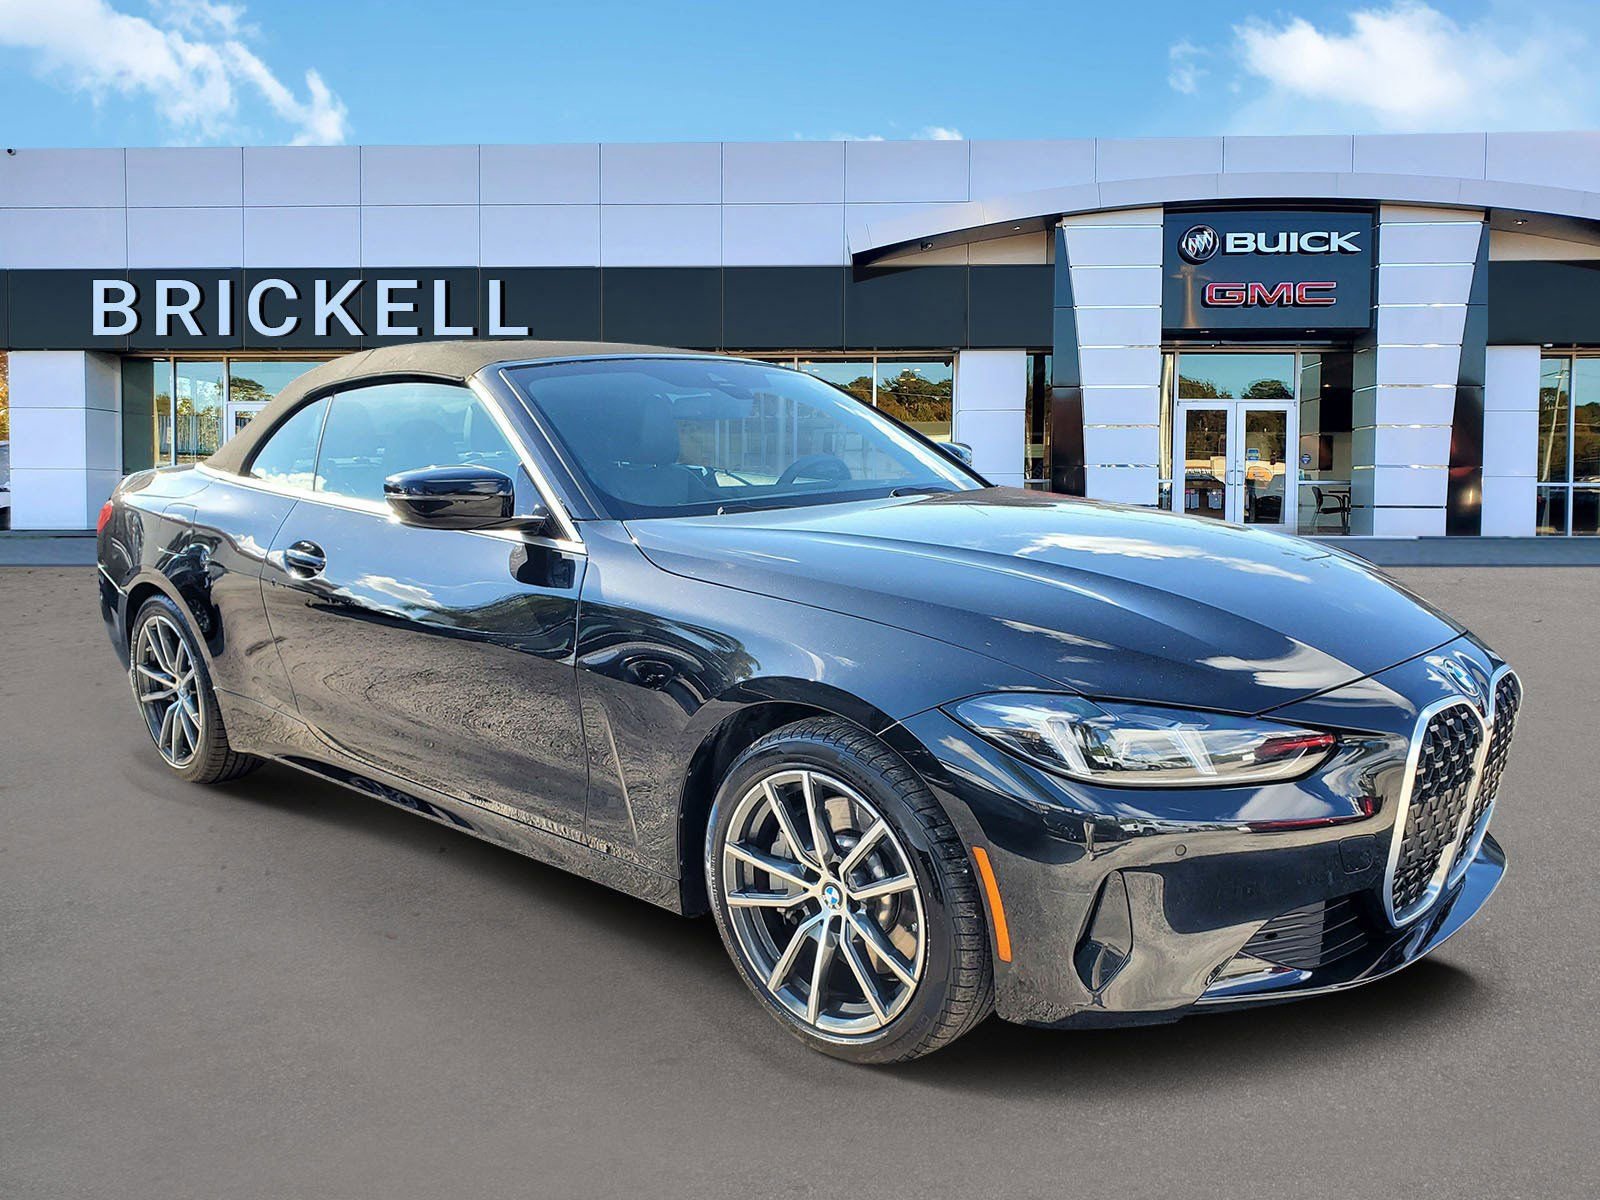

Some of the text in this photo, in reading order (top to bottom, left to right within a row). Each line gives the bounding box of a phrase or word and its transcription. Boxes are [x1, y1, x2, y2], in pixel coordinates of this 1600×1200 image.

[1224, 231, 1362, 253] BUICK
[1205, 281, 1337, 305] GMC
[92, 278, 530, 337] BRICKELL
